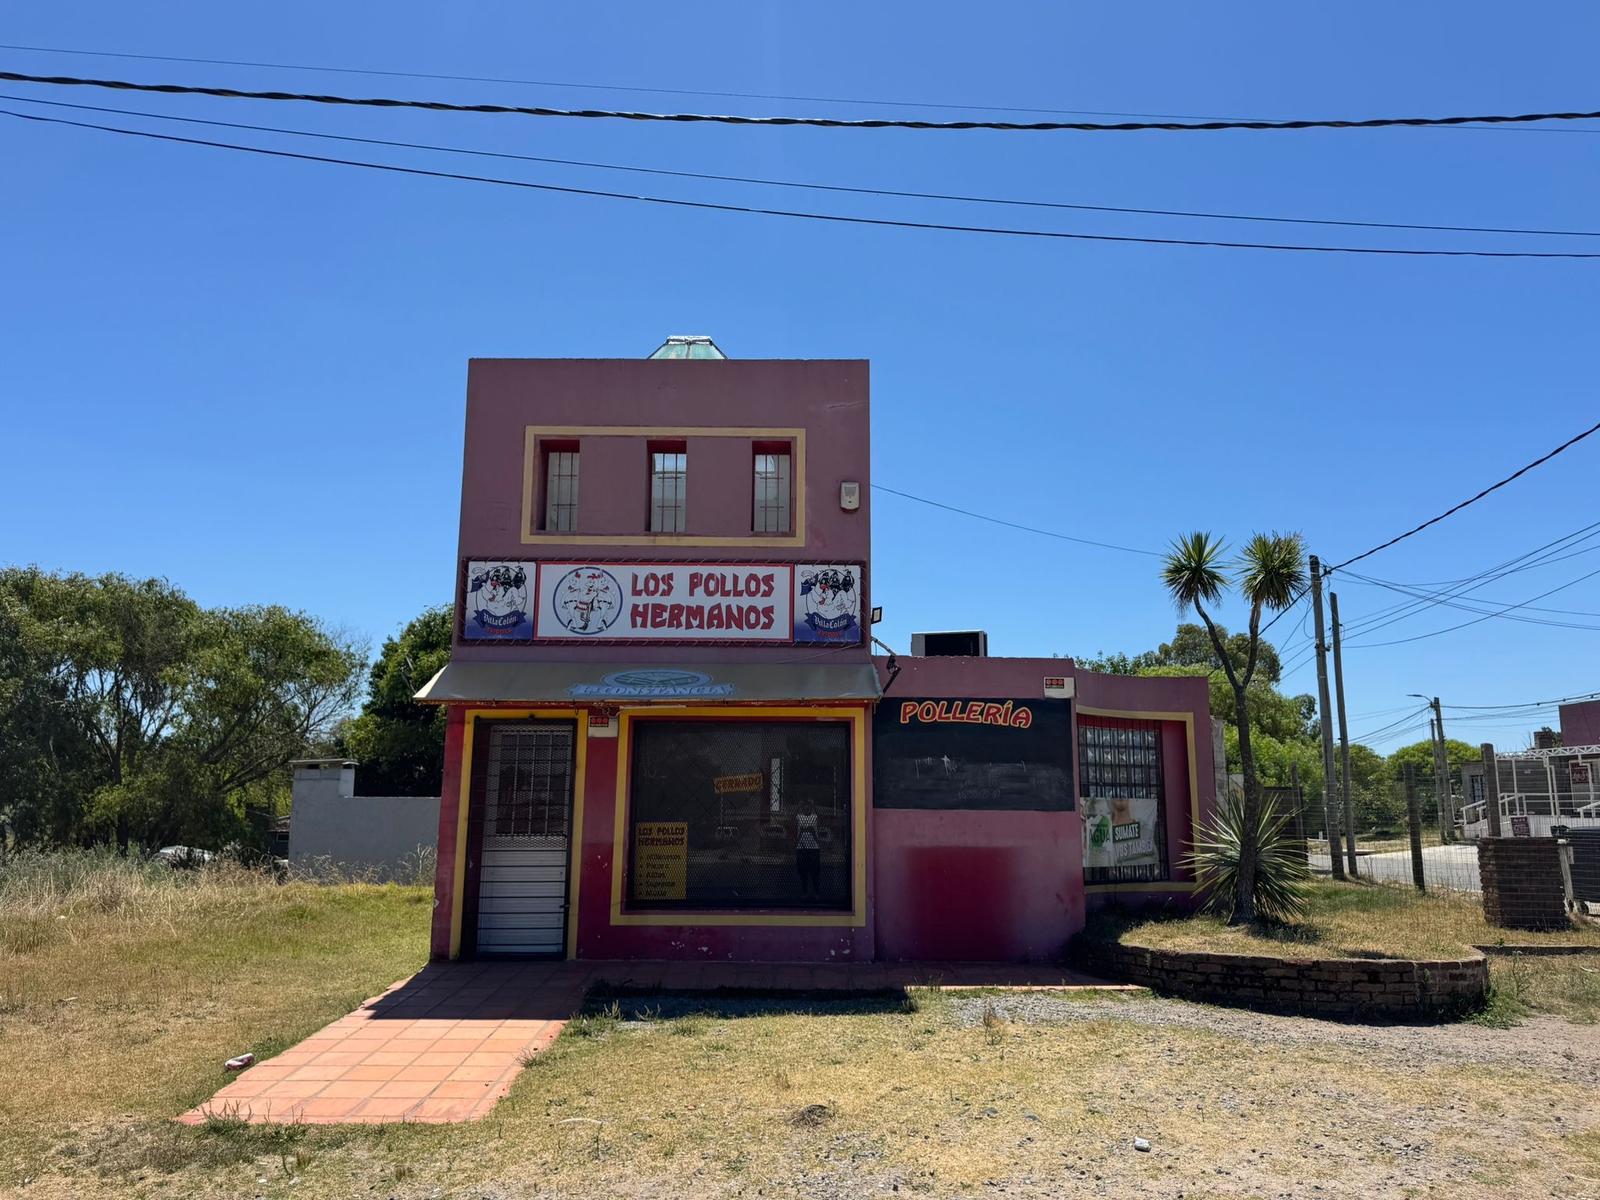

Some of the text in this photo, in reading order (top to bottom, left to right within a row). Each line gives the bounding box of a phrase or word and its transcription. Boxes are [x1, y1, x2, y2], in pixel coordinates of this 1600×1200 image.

[631, 571, 775, 597] LOS POLLOS
[630, 602, 775, 631] HERMANOS
[900, 700, 1033, 728] POLLERÍA
[638, 827, 685, 836] LOS POLLOS
[638, 837, 685, 847] HERMANOS
[1114, 823, 1139, 841] SUMATE
